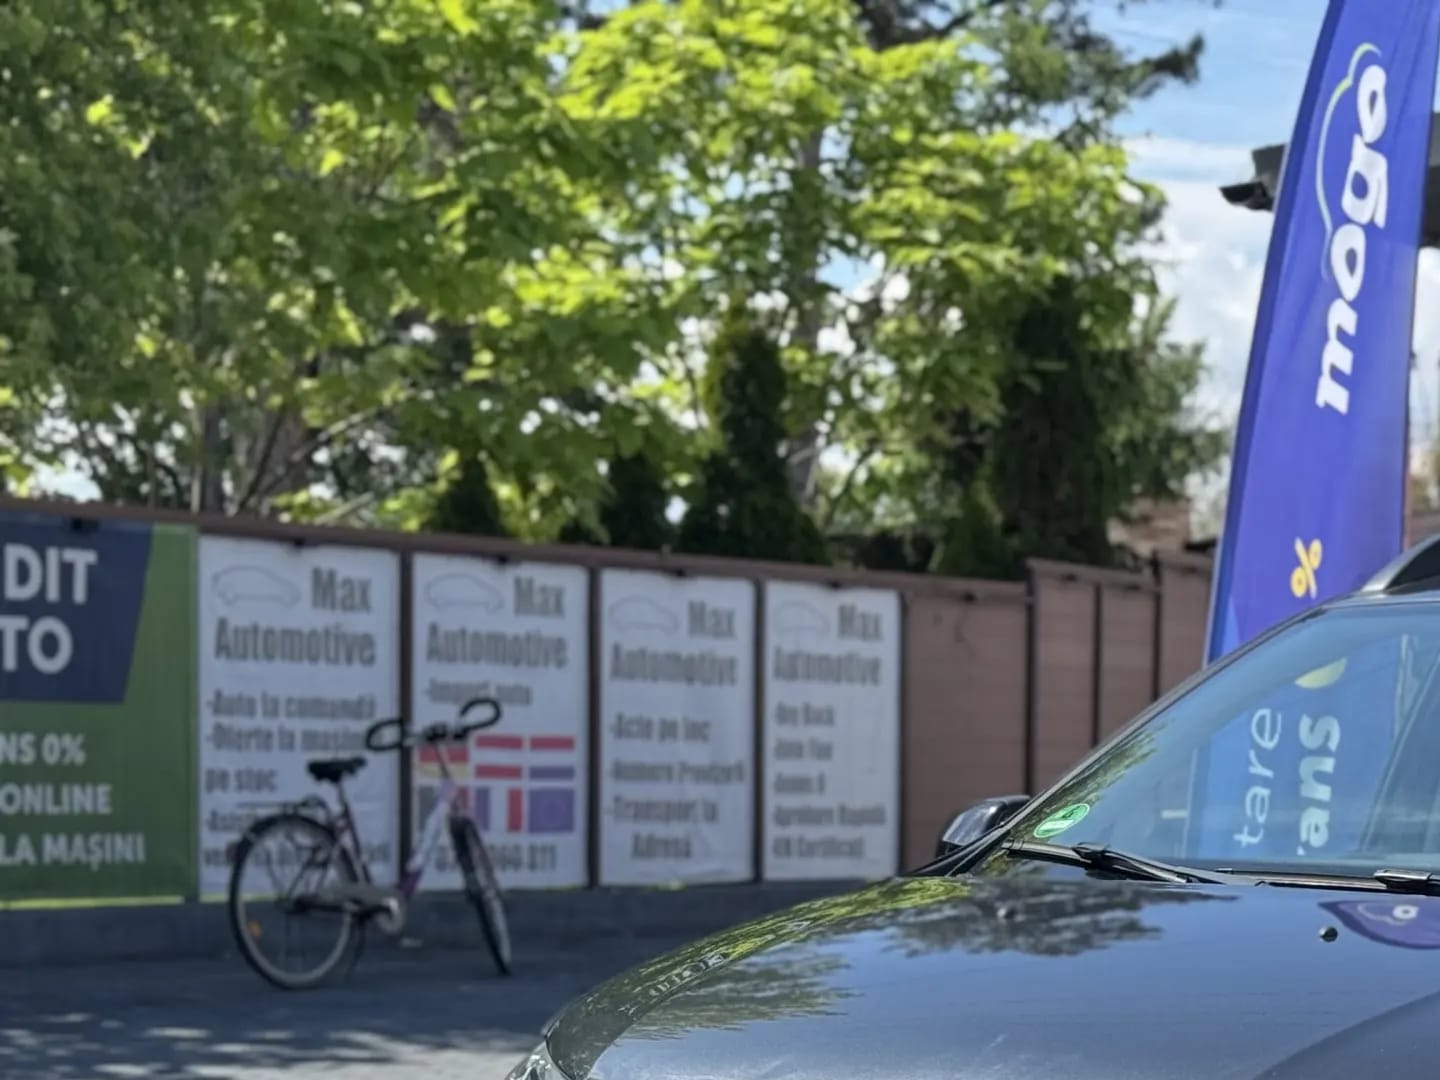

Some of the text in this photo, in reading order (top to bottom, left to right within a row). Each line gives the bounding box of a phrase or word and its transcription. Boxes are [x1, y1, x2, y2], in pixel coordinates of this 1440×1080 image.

[1316, 64, 1389, 415] mogo
[4, 543, 98, 605] DIT
[312, 566, 371, 613] Max
[514, 575, 565, 618] Max
[0, 614, 74, 674] TO
[214, 616, 376, 668] Automotive
[426, 620, 568, 669] Automotive
[688, 600, 736, 639] Max
[0, 782, 113, 816] ONLINE
[1233, 707, 1282, 848] tare
[1296, 713, 1341, 856] ans
